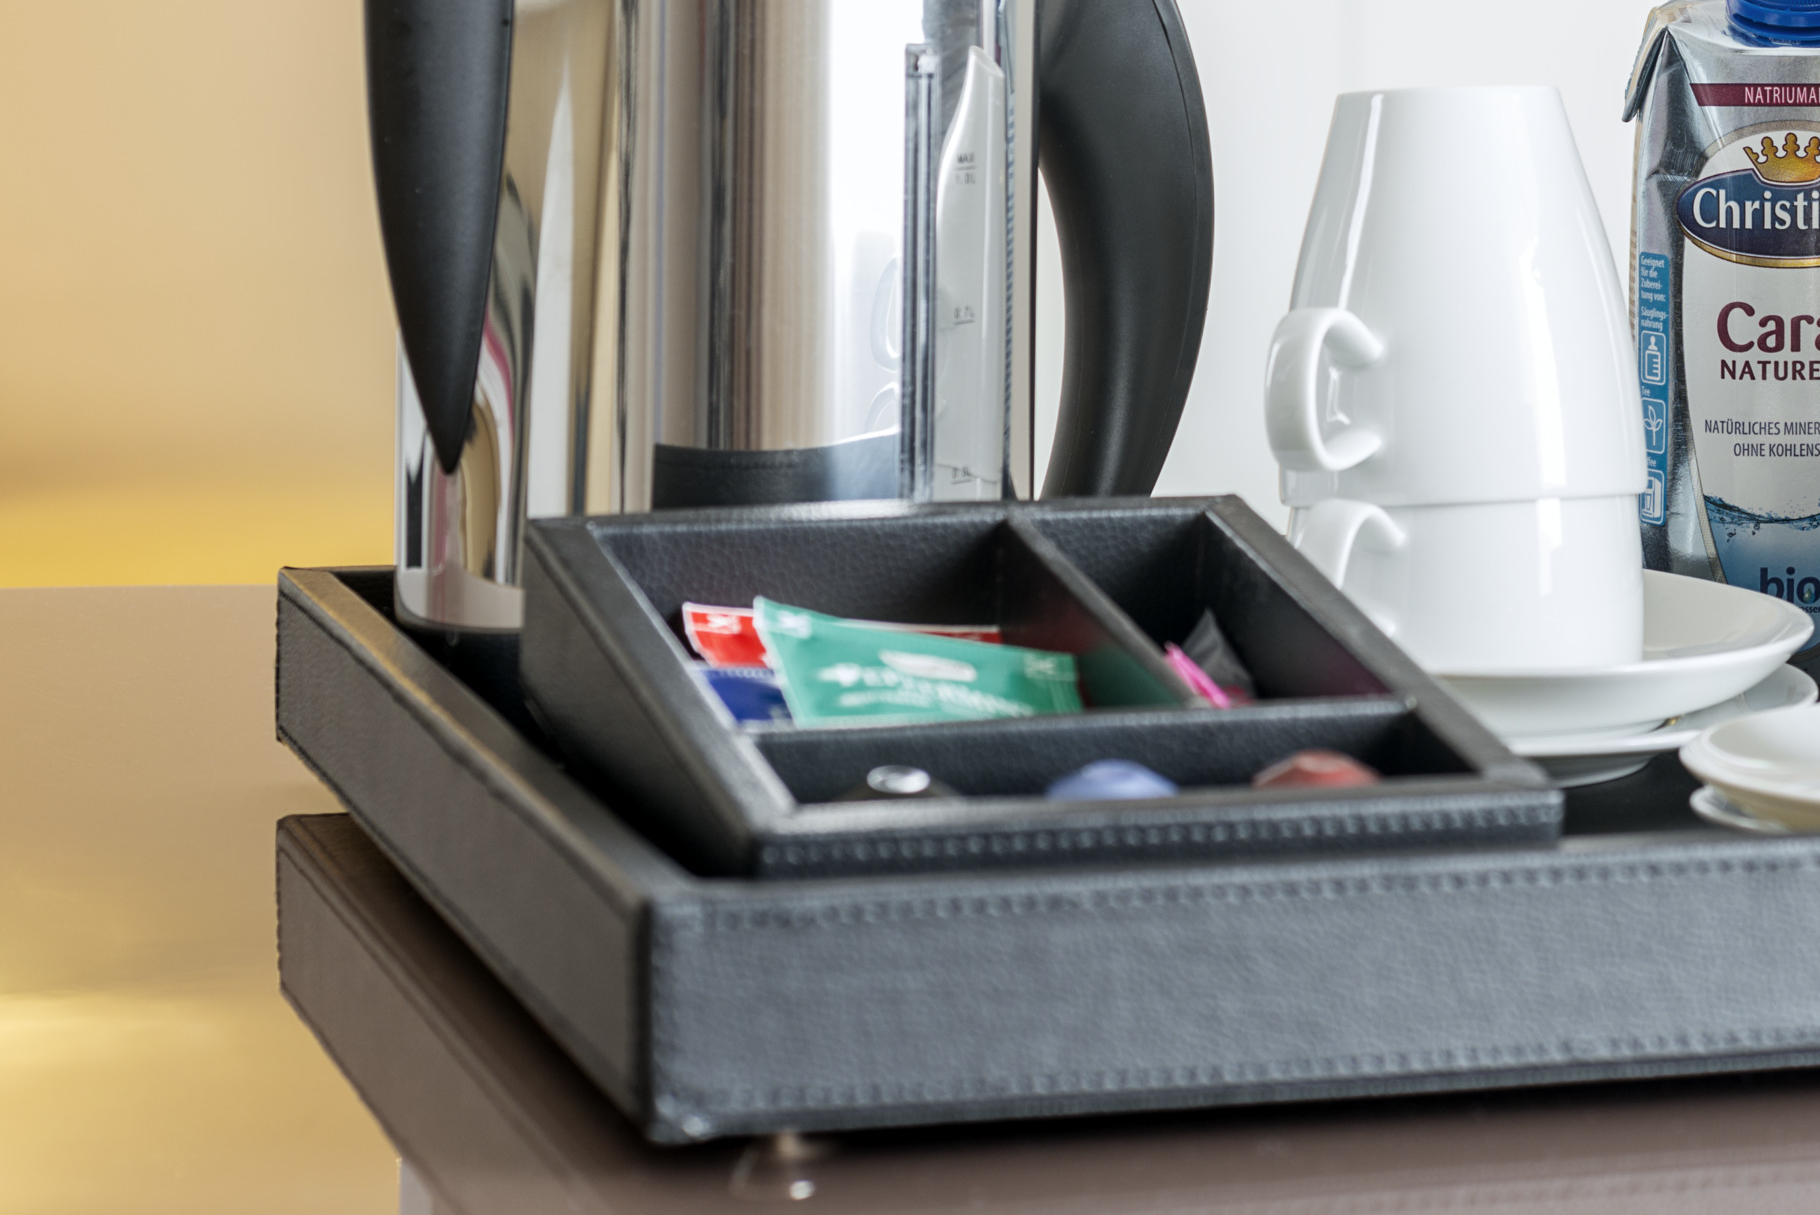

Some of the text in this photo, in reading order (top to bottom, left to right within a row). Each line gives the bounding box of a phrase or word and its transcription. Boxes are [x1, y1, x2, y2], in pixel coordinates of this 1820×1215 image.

[1641, 255, 1665, 268] Geeignet
[1641, 266, 1658, 278] für die
[1641, 277, 1663, 290] Zuberei-
[1641, 290, 1666, 302] tung von:
[1641, 318, 1663, 332] nahrung
[1641, 385, 1651, 397] Tee
[1704, 418, 1781, 436] NATÜRLICHES
[1733, 442, 1766, 457] OHNE
